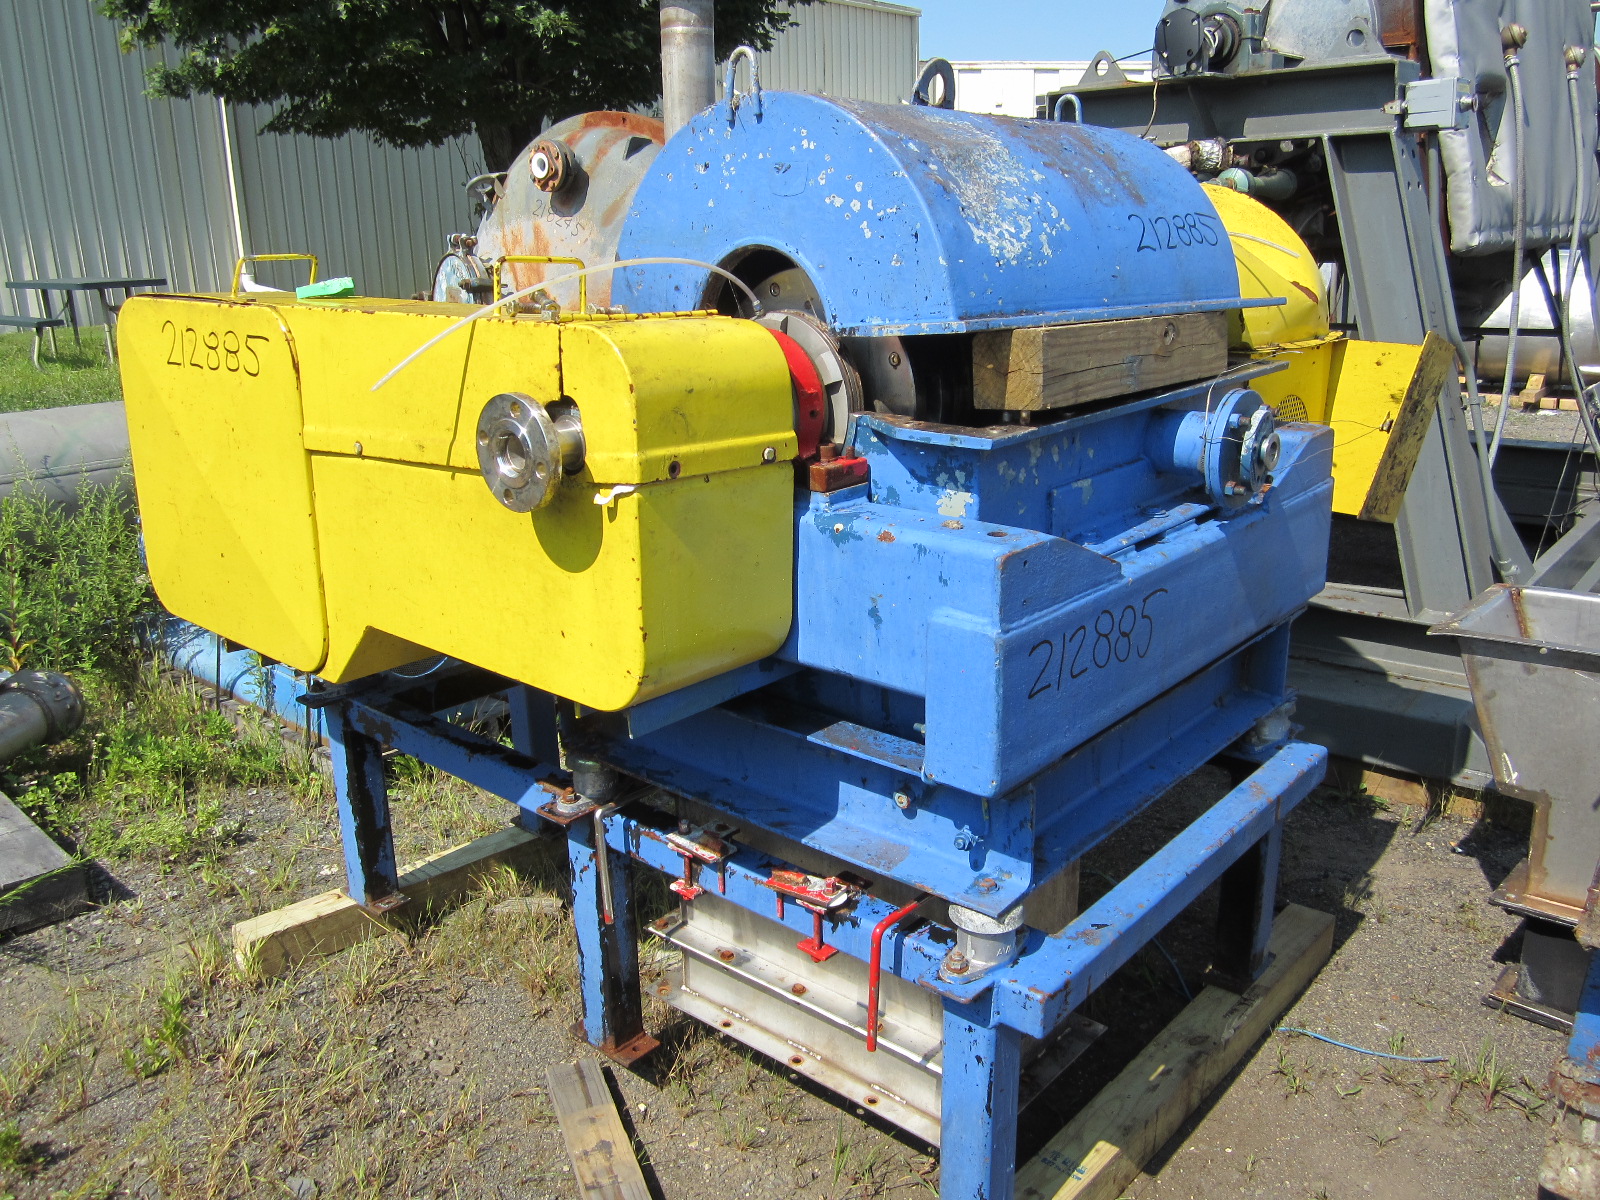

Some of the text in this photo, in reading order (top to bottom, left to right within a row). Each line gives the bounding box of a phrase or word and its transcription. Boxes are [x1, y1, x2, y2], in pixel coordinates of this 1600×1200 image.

[1128, 212, 1218, 252] 212885
[161, 320, 270, 377] 212885
[1027, 587, 1169, 700] 212885
